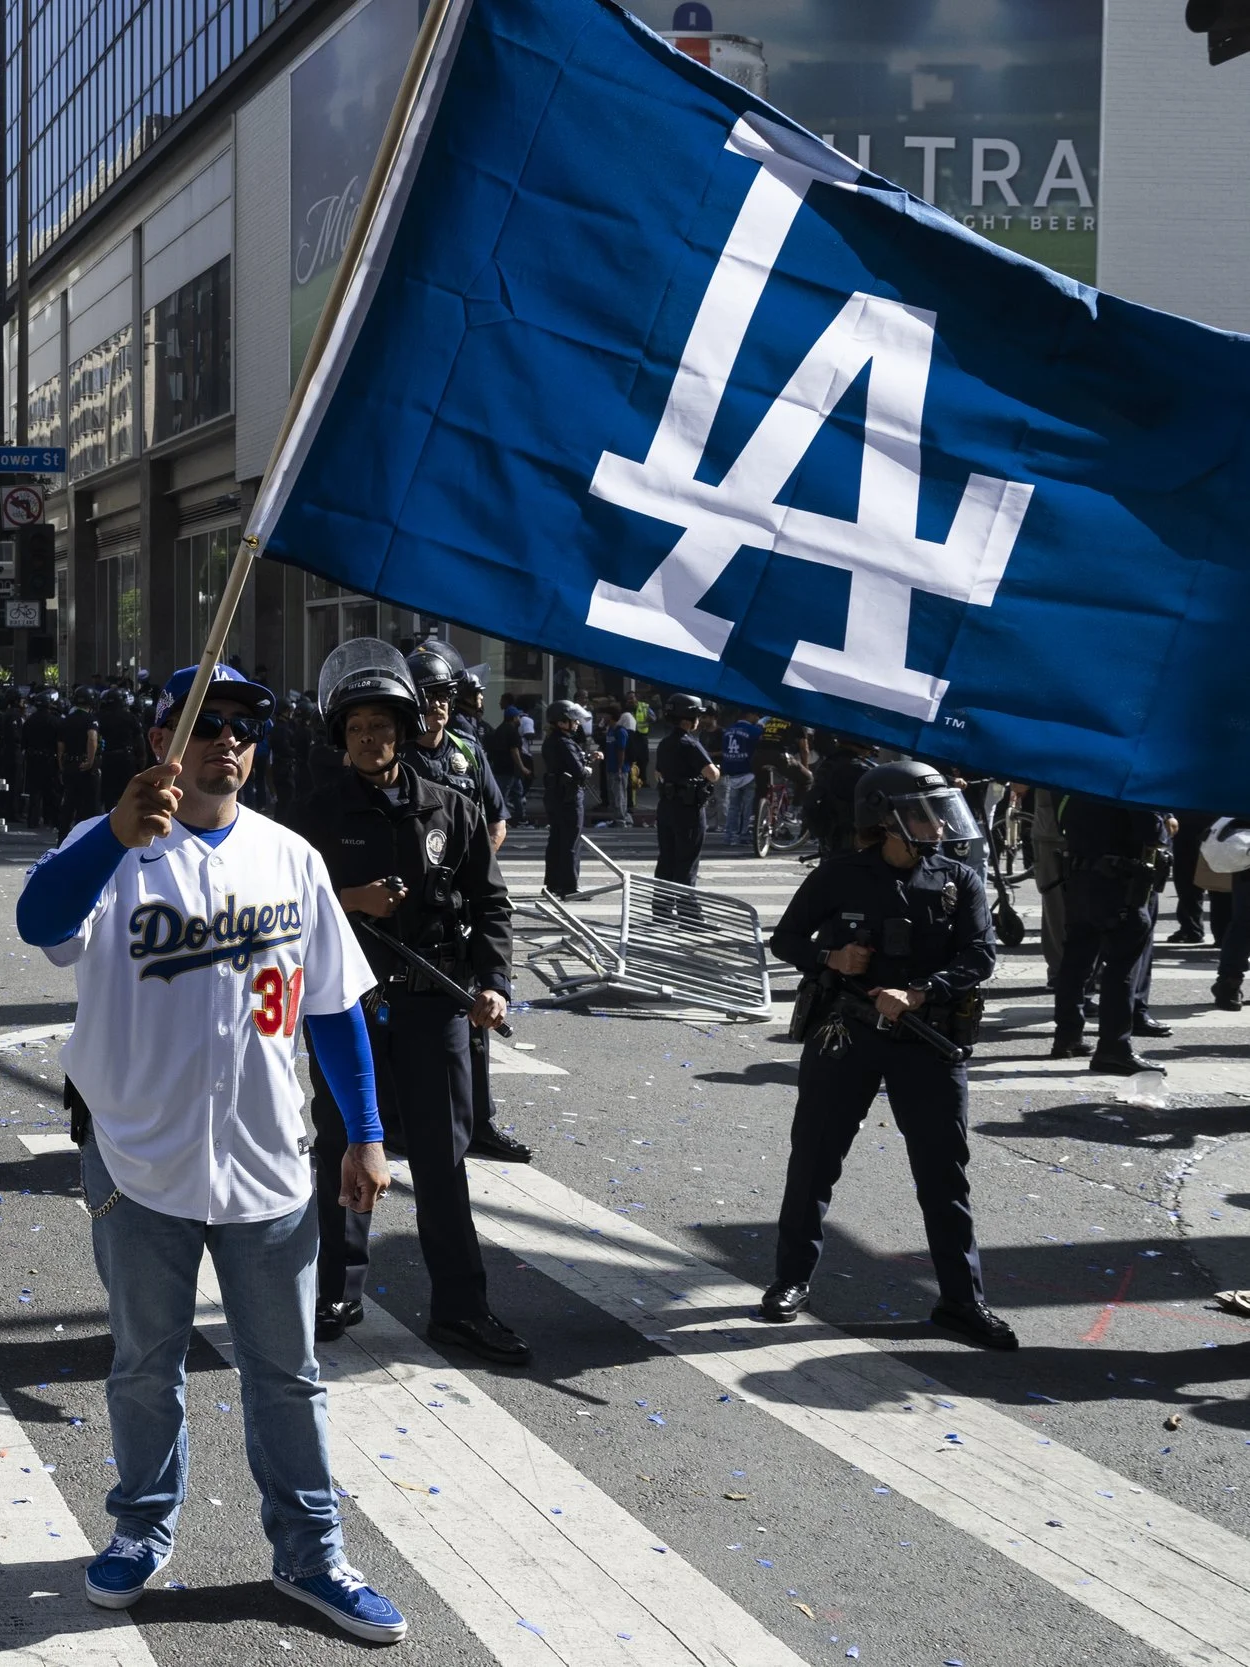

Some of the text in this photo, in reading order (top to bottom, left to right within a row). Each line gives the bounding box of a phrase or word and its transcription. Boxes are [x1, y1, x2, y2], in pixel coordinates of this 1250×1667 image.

[822, 134, 1094, 207] TRA
[952, 215, 1095, 231] GHT BEER
[585, 110, 1035, 722] LA
[42, 452, 59, 466] St
[347, 680, 372, 691] TAYLOR
[944, 716, 966, 729] TM
[341, 838, 366, 846] TAYLOR
[129, 892, 302, 974] Dodgers
[252, 966, 303, 1038] 31
